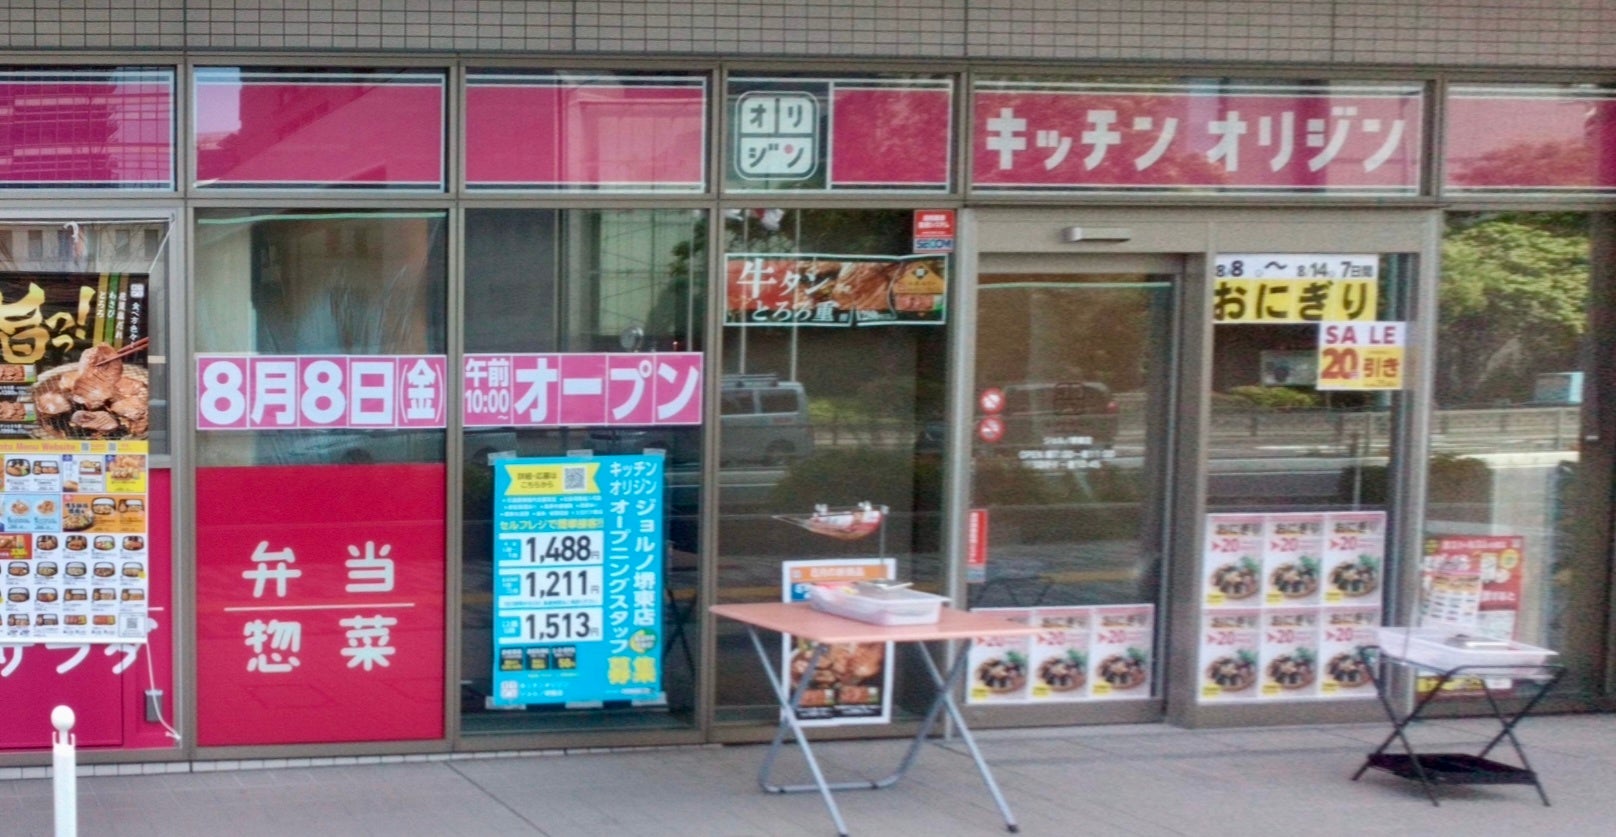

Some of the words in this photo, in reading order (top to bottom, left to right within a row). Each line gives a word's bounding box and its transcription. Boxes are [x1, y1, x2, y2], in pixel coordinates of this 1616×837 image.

[986, 107, 1178, 171] キッチン
[1206, 106, 1405, 173] オリジン
[736, 258, 831, 299] 牛タン
[752, 300, 840, 322] とろろ重
[1215, 280, 1367, 321] おにぎり
[200, 359, 444, 425] 8月8日(金)
[465, 358, 509, 387] 午前
[514, 358, 699, 422] オープン
[465, 389, 510, 414] 10:00
[609, 461, 657, 477] キッチン
[609, 479, 657, 496] オリジン
[242, 540, 396, 598] 弁当
[608, 500, 631, 655] オープニングスタッフ
[243, 614, 398, 674] 惣菜
